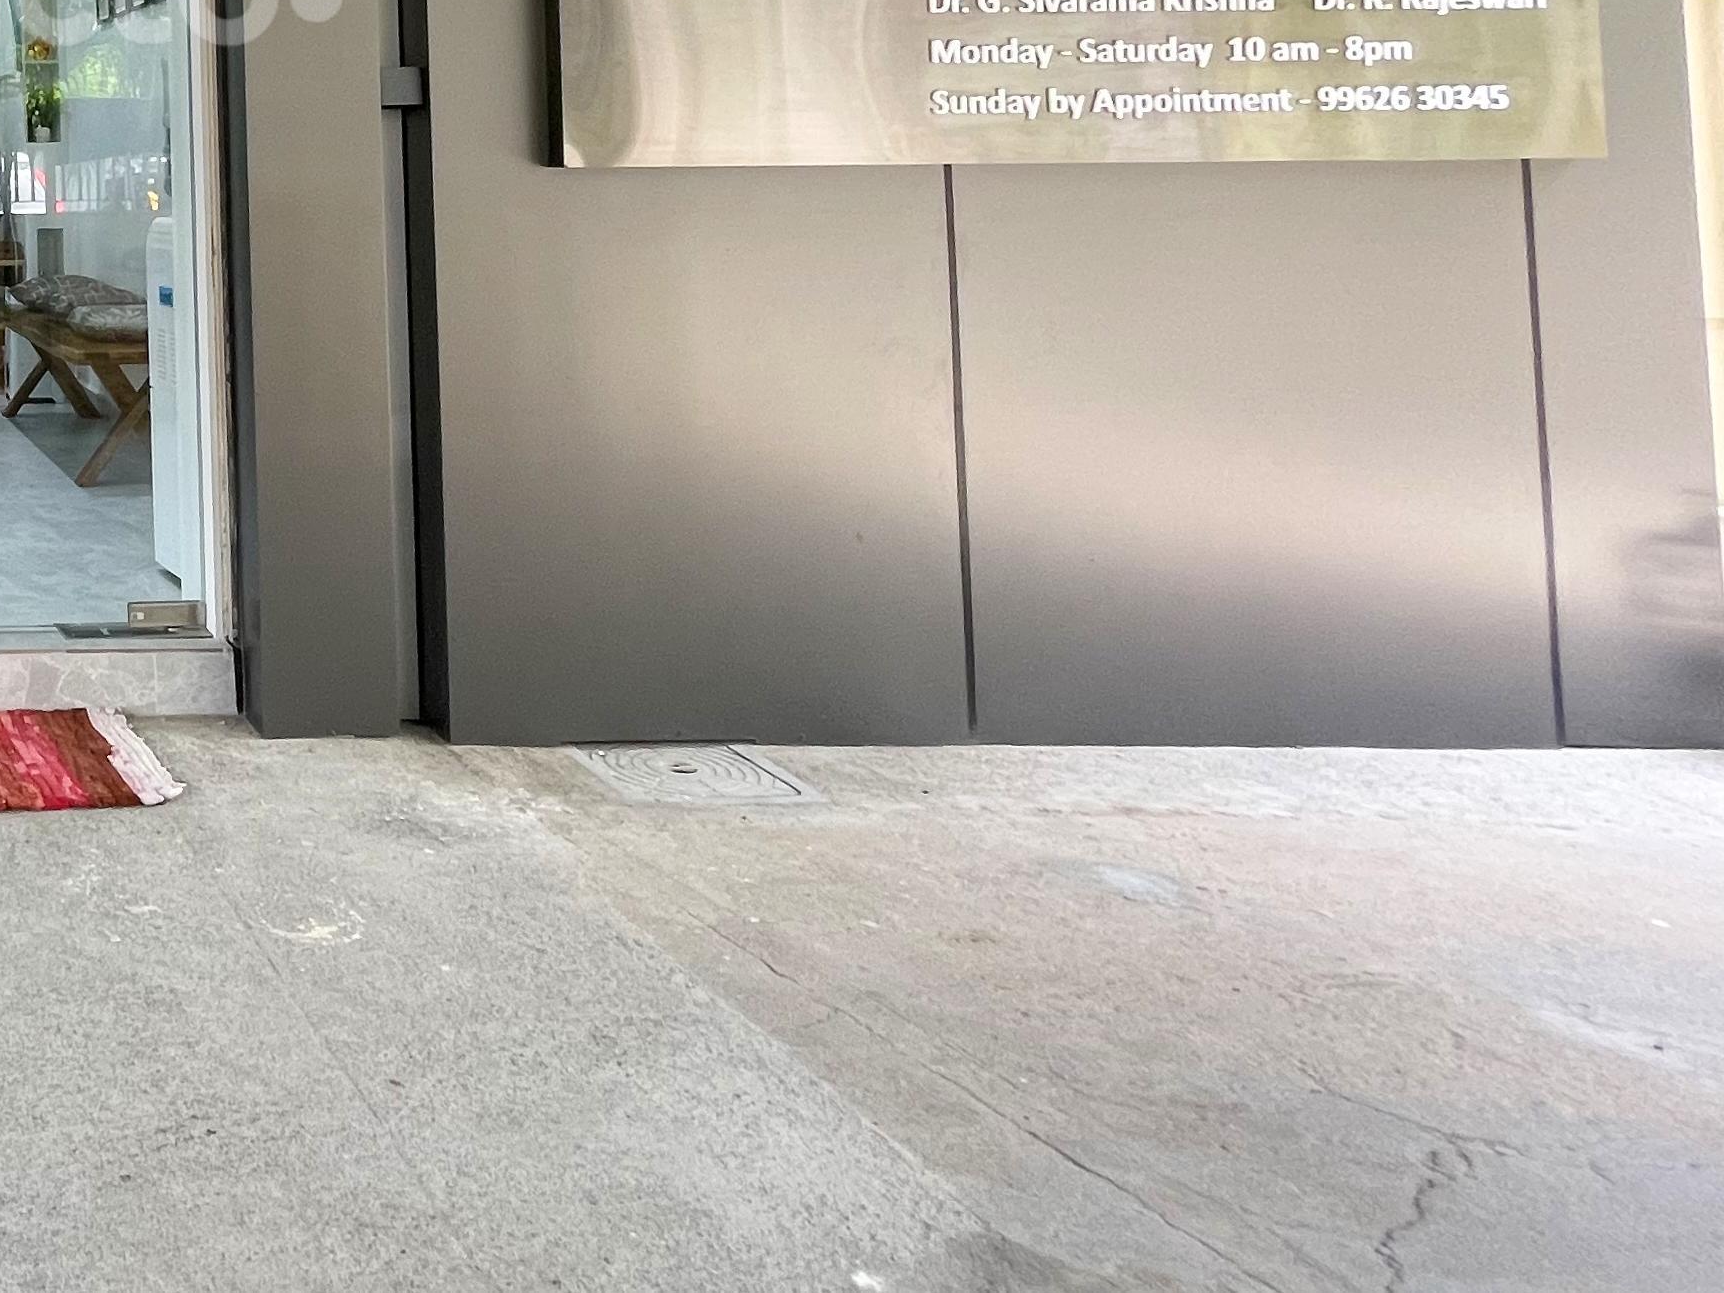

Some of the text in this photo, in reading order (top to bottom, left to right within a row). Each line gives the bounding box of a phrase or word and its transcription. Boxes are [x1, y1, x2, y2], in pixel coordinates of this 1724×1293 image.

[929, 37, 1055, 69] Monday
[1078, 36, 1214, 69] Saturday
[1227, 35, 1267, 62] 10
[1271, 40, 1320, 62] am
[1343, 34, 1414, 67] 8pm
[930, 87, 1042, 120] Sunday
[1046, 87, 1086, 120] by
[1091, 87, 1295, 120] Appointment
[1316, 85, 1412, 112] 99626
[1415, 84, 1511, 111] 30345
